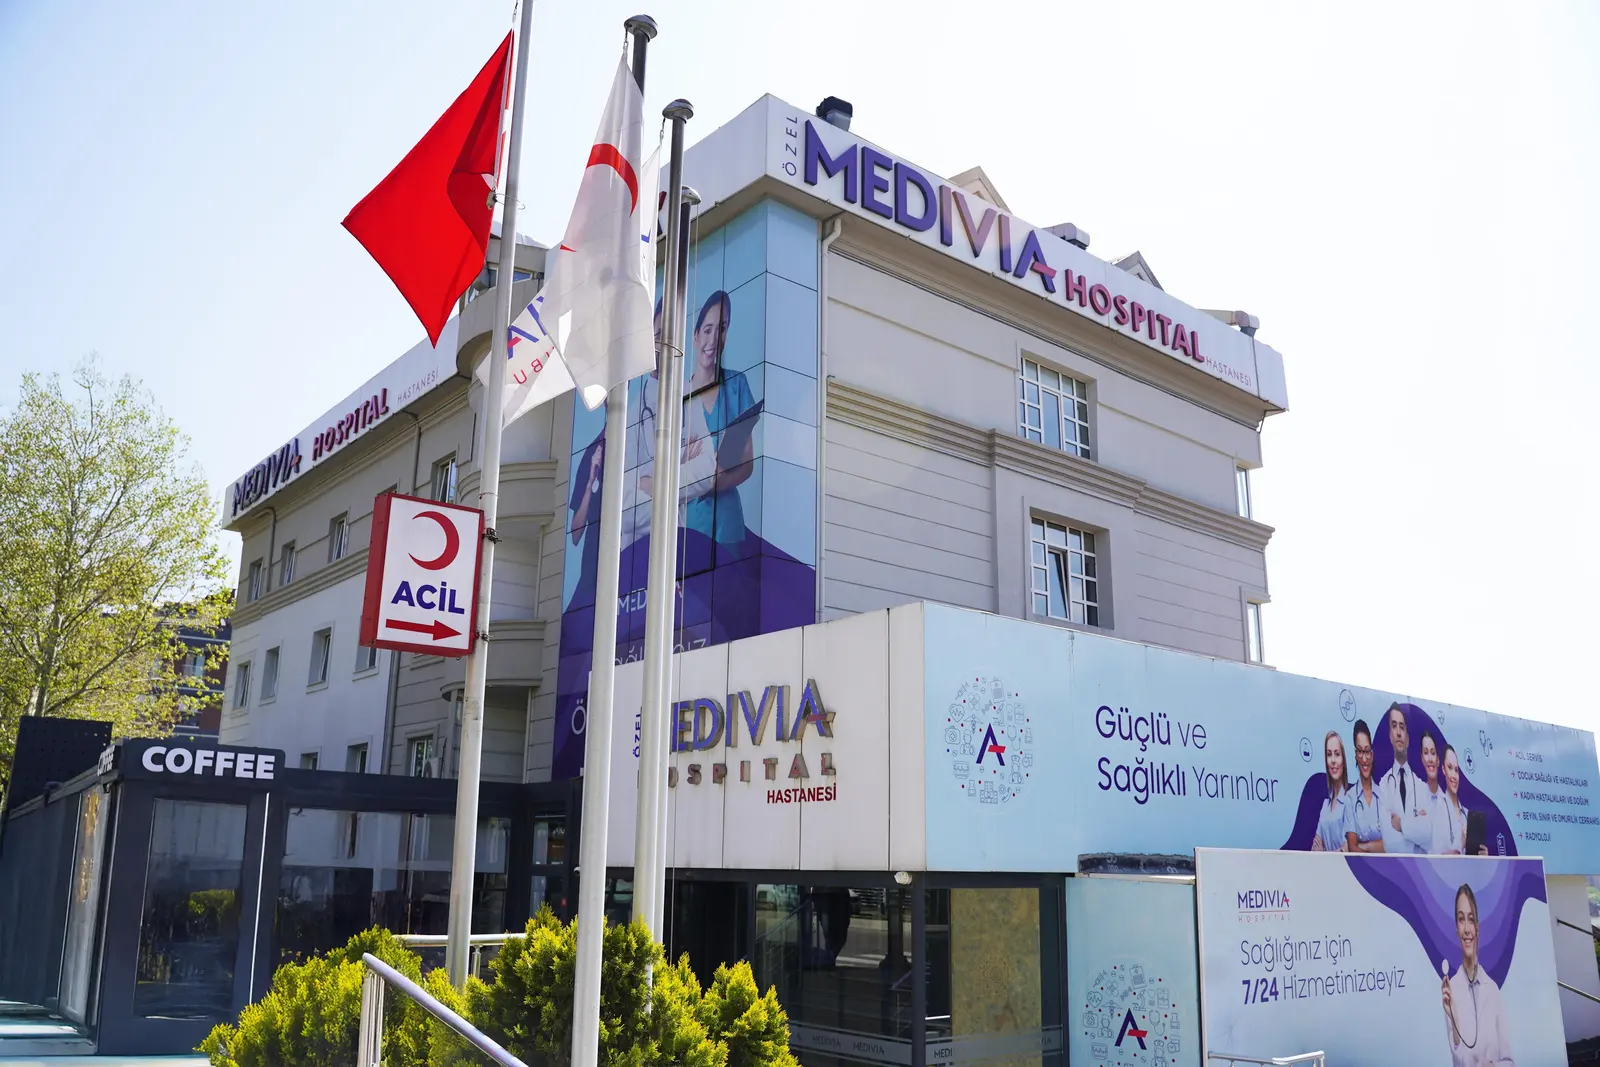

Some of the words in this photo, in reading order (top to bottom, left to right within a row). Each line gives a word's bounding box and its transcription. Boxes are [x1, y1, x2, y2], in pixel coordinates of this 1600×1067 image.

[782, 116, 798, 176] ÖZEL
[804, 119, 1057, 293] MEDIVIA
[1065, 269, 1205, 363] HOSPITAL
[231, 438, 302, 516] MEDIVIA
[312, 388, 389, 460] HOSPITAL
[391, 581, 465, 614] ACİL
[670, 679, 836, 753] EDIVIA
[1096, 706, 1171, 752] Güçlü
[1178, 722, 1207, 749] ve
[142, 746, 276, 780] COFFEE
[1098, 757, 1186, 805] Sağlıklı
[1192, 766, 1279, 802] Yarınlar
[767, 783, 837, 804] HASTANESİ
[1238, 890, 1290, 908] MEDIVIA
[1241, 936, 1321, 972] Sağlığınız
[1325, 935, 1352, 965] için
[1242, 977, 1279, 1005] 7/24
[1283, 966, 1405, 1000] Hizmetinizdeyiz
